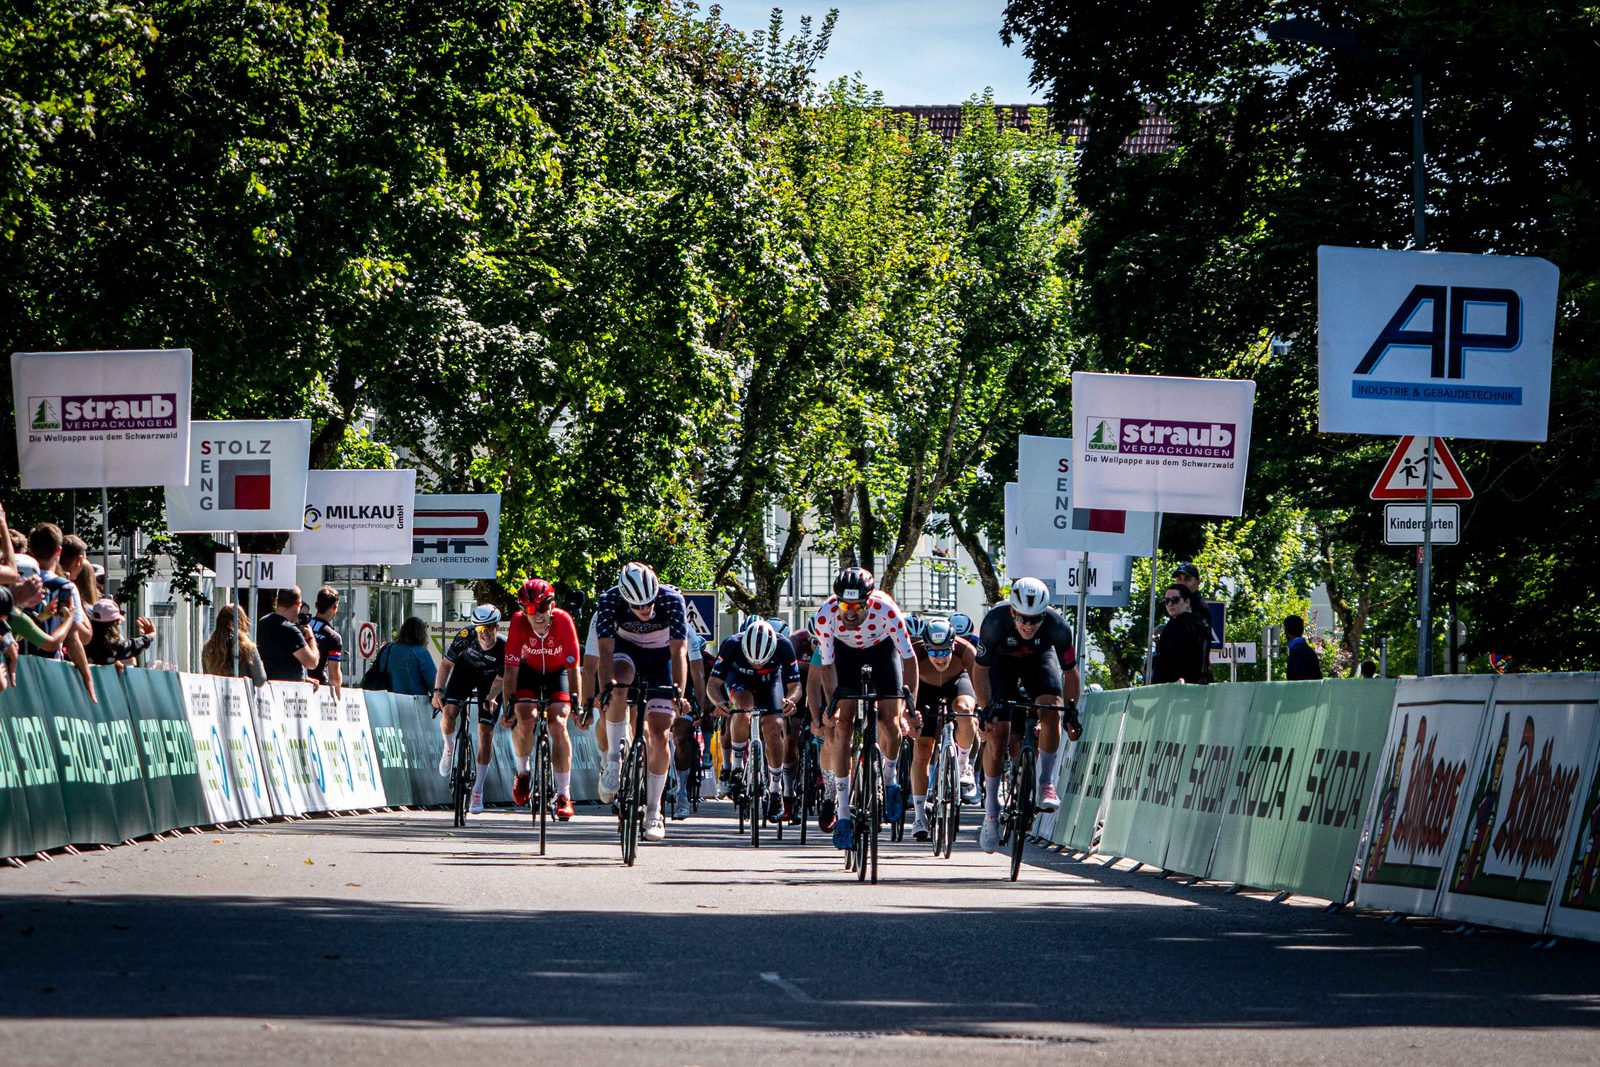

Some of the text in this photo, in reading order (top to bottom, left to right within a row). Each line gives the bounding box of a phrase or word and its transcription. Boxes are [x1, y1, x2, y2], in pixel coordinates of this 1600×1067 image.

[1353, 284, 1523, 379] AP
[1358, 384, 1409, 397] INDUSTRIE
[1412, 388, 1420, 397] &
[65, 395, 174, 420] straub
[65, 419, 173, 430] VERPACKUNGEN
[29, 431, 178, 444] Die Wellpappe aus dem Schwarzwald
[1122, 422, 1233, 447] straub
[201, 440, 272, 455] STOLZ
[1123, 444, 1231, 457] VERPACKUNGEN
[1085, 454, 1098, 463] Die
[1100, 455, 1143, 466] Wellpappe
[1162, 459, 1179, 467] dem
[1181, 459, 1235, 469] Schwarzwald
[1053, 458, 1069, 530] SENG
[326, 505, 395, 520] MILKAU
[325, 522, 395, 530] Reinigungstechnologie
[439, 556, 490, 564] HEBETECHNIK
[260, 561, 274, 581] M
[1087, 567, 1097, 588] M
[1237, 646, 1246, 659] M
